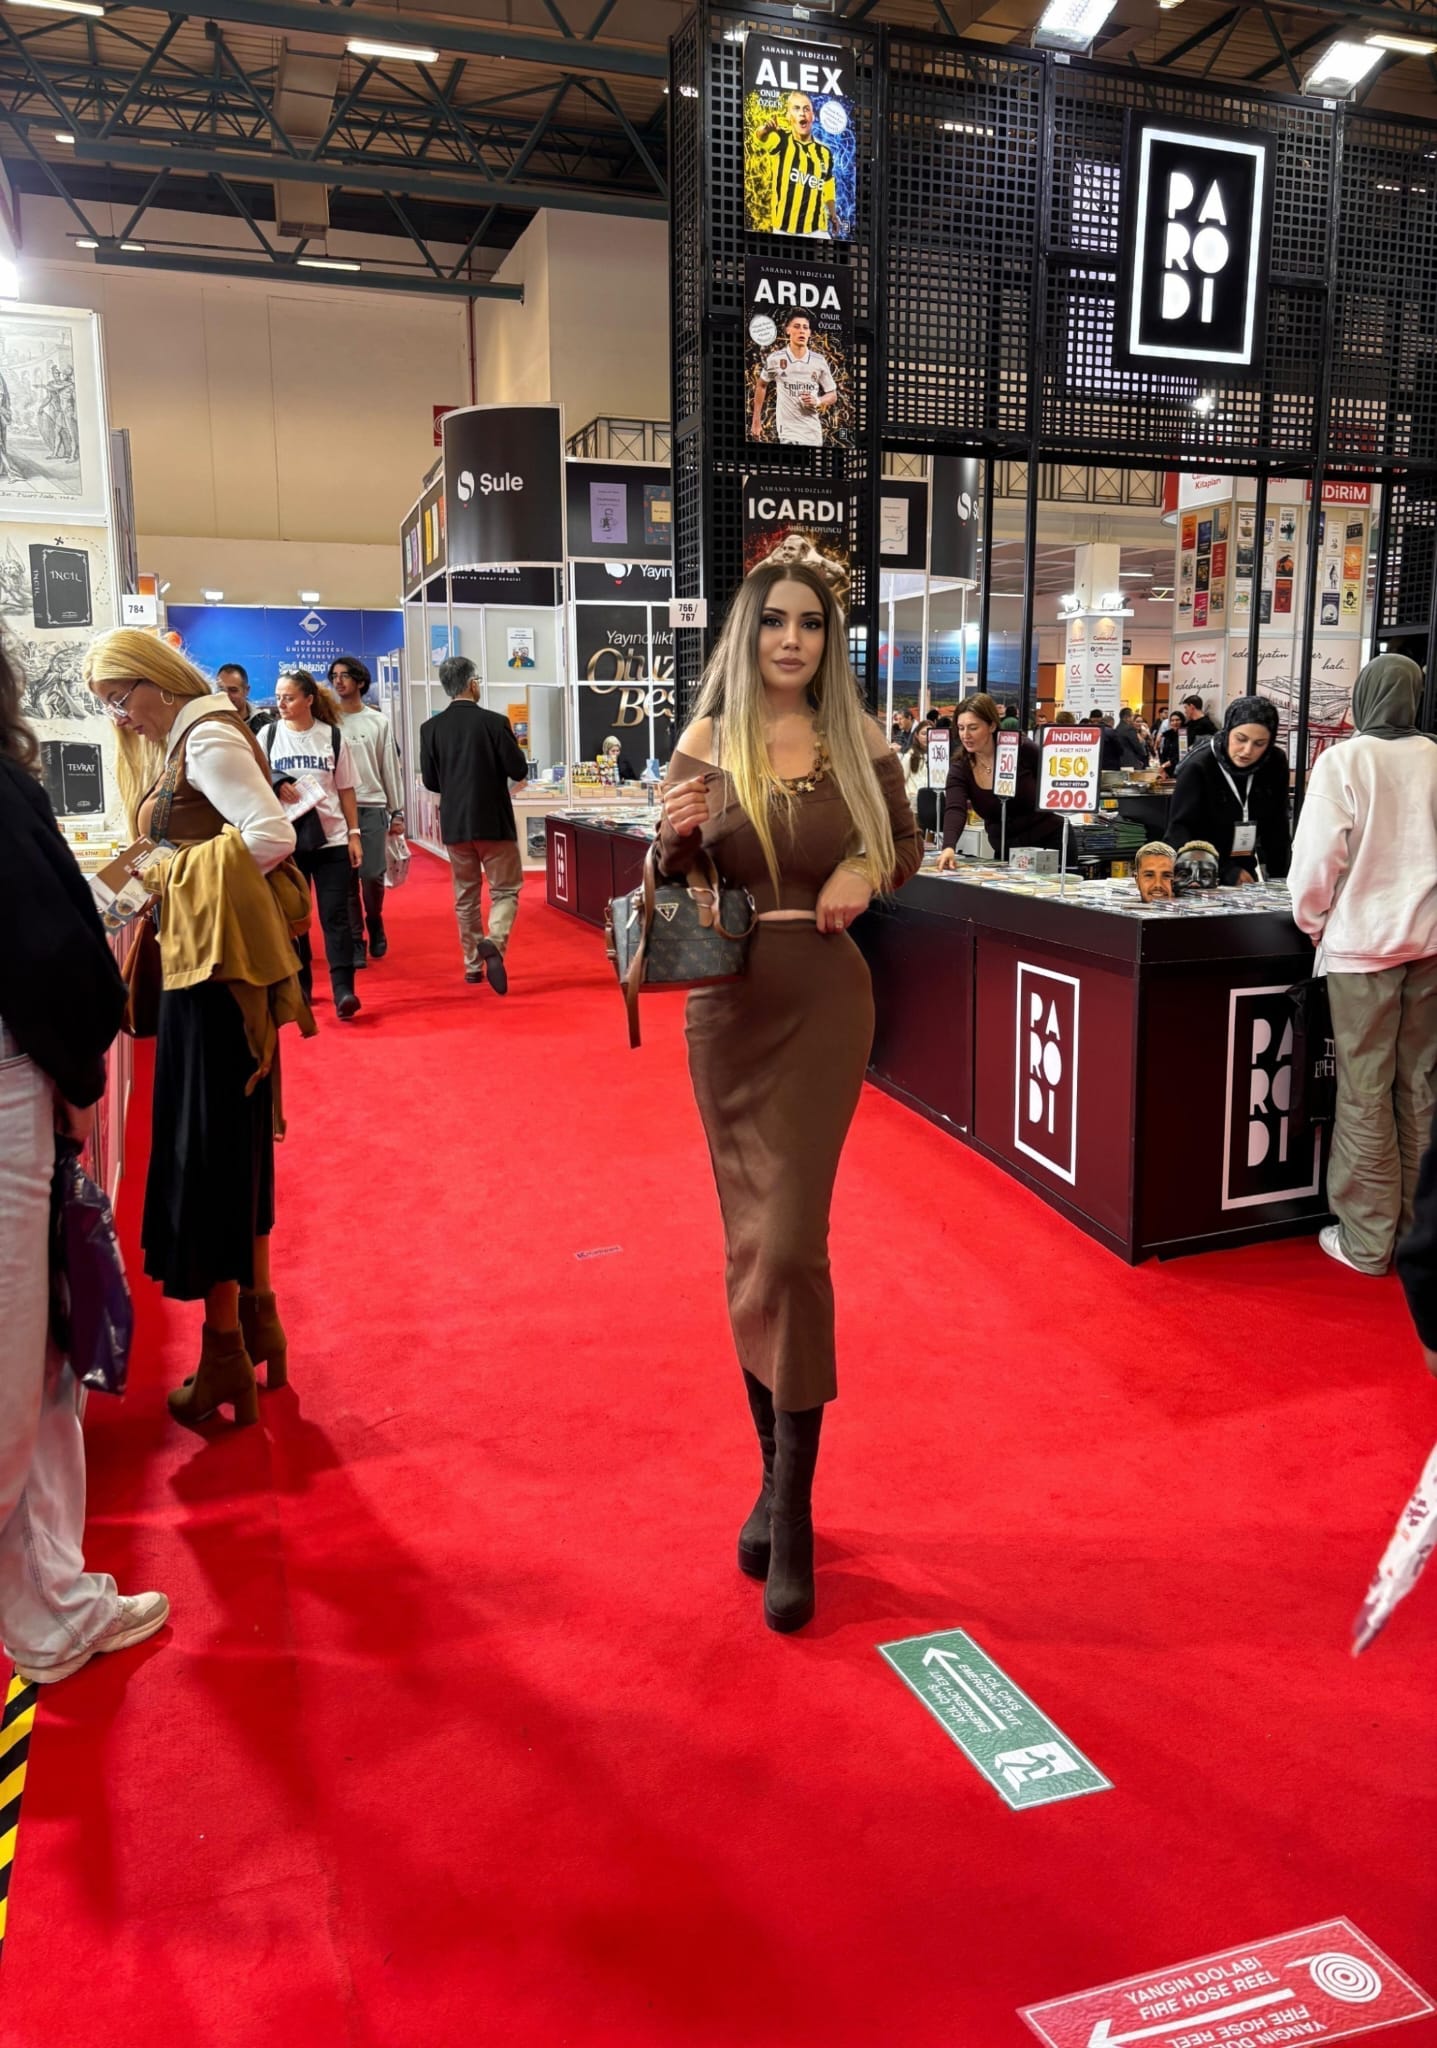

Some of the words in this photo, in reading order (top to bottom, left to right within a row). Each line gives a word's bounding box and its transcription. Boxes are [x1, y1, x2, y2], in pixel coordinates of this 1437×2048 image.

[761, 45, 794, 56] SAHANIN
[796, 50, 837, 62] YILDIZLARI
[755, 58, 844, 96] ALEX
[790, 168, 825, 191] avea
[754, 279, 841, 311] ARDA
[820, 313, 841, 321] ONUR
[480, 472, 524, 495] Şule
[748, 497, 844, 522] ICARDI
[128, 604, 144, 614] 784
[678, 603, 694, 613] 766
[681, 613, 695, 623] 767
[1052, 731, 1093, 742] İNDİRİM
[67, 763, 96, 773] TEVRAT
[1049, 756, 1089, 778] 150
[1046, 789, 1087, 808] 200
[929, 1671, 950, 1686] EXIT
[958, 1664, 1006, 1708] EMERGENCY
[999, 1709, 1023, 1726] EXIT
[943, 1686, 992, 1733] EMERGENCY
[1124, 1976, 1194, 2005] YANGIN
[1195, 1957, 1261, 1987] DOLABI
[1139, 1998, 1181, 2021] FIRE
[1185, 1983, 1232, 2008] HOSE
[1233, 1970, 1281, 1993] REEL
[1267, 2004, 1312, 2024] FIRE
[1165, 2029, 1216, 2048] REEL
[1217, 2016, 1268, 2039] HOSE
[1256, 2020, 1328, 2046] YANGIN
